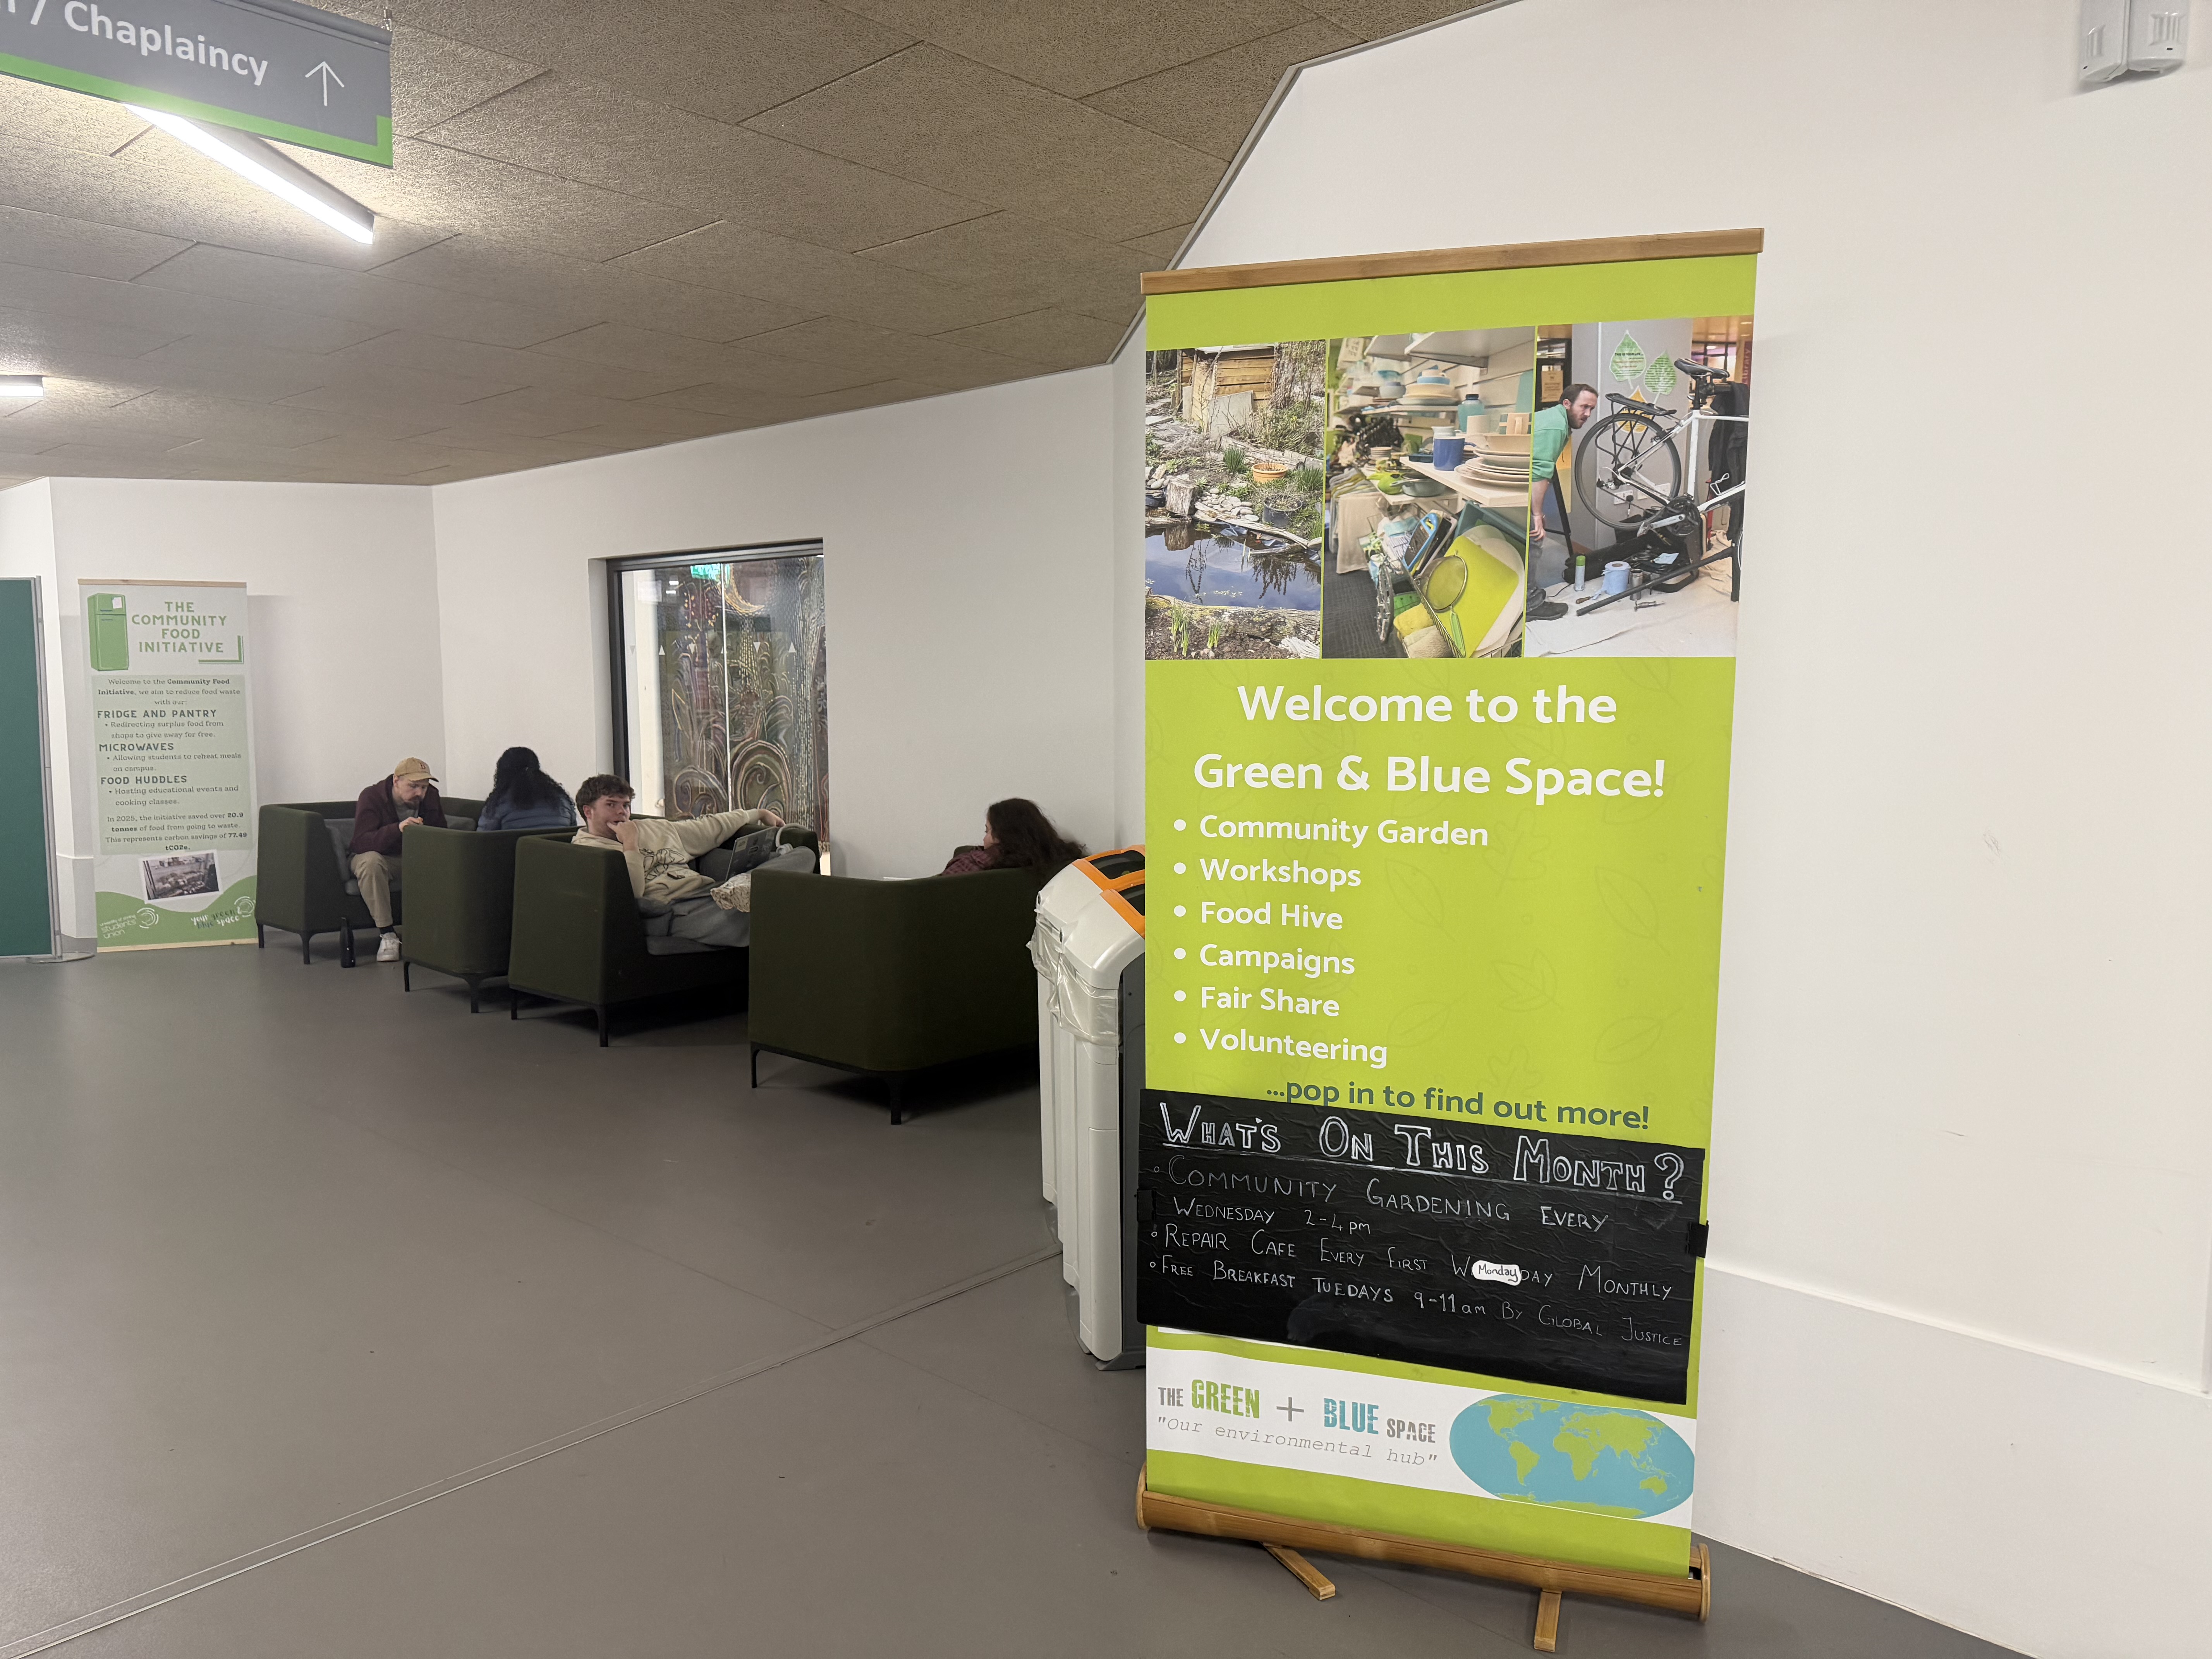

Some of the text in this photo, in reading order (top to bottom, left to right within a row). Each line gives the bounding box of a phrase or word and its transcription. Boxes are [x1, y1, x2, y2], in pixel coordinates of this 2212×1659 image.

[65, 1, 267, 86] Chaplaincy
[132, 614, 227, 626] COMMUNITY
[165, 601, 194, 612] THE
[139, 642, 223, 653] INITIATIVE
[162, 629, 200, 639] FOOD
[1237, 685, 1617, 723] Welcome to the
[99, 743, 173, 751] MICROWAVES
[136, 775, 187, 784] HUDDLES
[1194, 753, 1665, 805] Green & Blue Space!
[1200, 815, 1488, 848] Community Garden
[1200, 858, 1361, 892] Workshops
[1201, 901, 1343, 930] Food Hive
[1200, 944, 1355, 979] Campaigns
[1201, 986, 1340, 1017] Fair Share
[1200, 1028, 1388, 1069] Volunteering
[1349, 1081, 1374, 1104] in
[1383, 1085, 1415, 1108] to
[1424, 1087, 1483, 1115] find
[1494, 1101, 1547, 1122] out
[1558, 1106, 1649, 1130] more!
[1160, 1103, 1281, 1153] WHAT'S
[1319, 1116, 1374, 1162] ON
[1395, 1124, 1489, 1173] THIS
[1168, 1154, 1608, 1231] COMMUNITY GARDENING EVERY
[1174, 1196, 1275, 1224] WEDNESDAY
[1165, 1223, 1230, 1250] REPAIR
[1251, 1229, 1297, 1257] CAFE
[1321, 1238, 1364, 1267] EVERY
[1479, 1263, 1518, 1283] Monday
[1578, 1264, 1672, 1300] MONTHLY
[1162, 1255, 1194, 1276] FREE
[1213, 1261, 1295, 1288] BREAKFAST
[1312, 1278, 1393, 1302] TUEDAYS
[1503, 1302, 1523, 1320] BY
[1539, 1305, 1602, 1336] GLOBAL
[1622, 1317, 1682, 1346] JUSTICE
[1158, 1379, 1436, 1443] THE GREEN + BLUE SPACE
[1158, 1417, 1437, 1465] "Our environmental hub"
